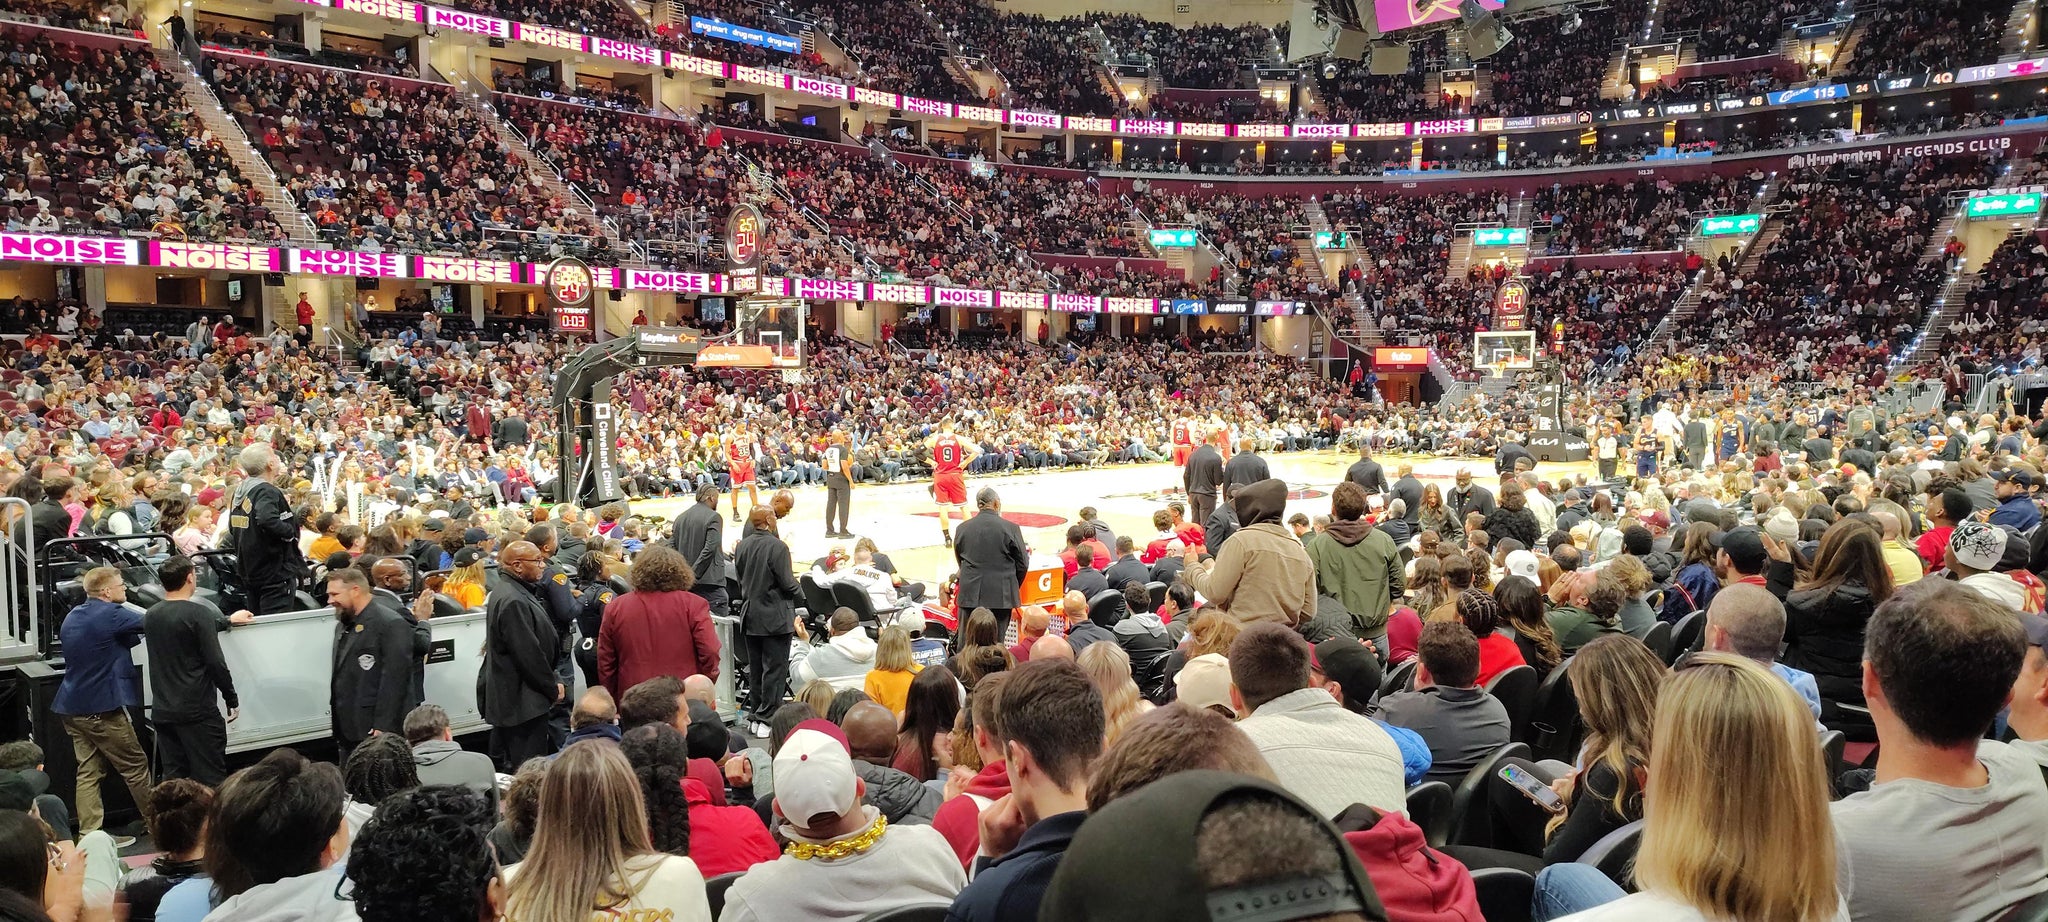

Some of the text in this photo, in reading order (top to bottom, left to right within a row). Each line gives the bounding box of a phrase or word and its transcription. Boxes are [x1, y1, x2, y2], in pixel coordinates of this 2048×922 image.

[343, 0, 416, 21] NOISE
[436, 10, 502, 33] NOISE
[695, 20, 728, 34] drug mart
[520, 28, 583, 51] NOISE
[732, 28, 763, 42] drug mart
[767, 36, 797, 49] drug mart
[670, 57, 724, 77] NOISE
[1970, 67, 1996, 80] 116
[737, 70, 786, 88] NOISE
[1932, 73, 1953, 85] 4Q
[798, 79, 843, 96] NOISE
[1813, 87, 1836, 99] 115
[1855, 83, 1869, 93] 24
[854, 93, 897, 108] NOISE
[1623, 108, 1655, 118] TOL 2
[1667, 102, 1711, 114] FOULS 5
[958, 110, 1003, 123] NOISE
[1014, 113, 1057, 125] NOISE
[1507, 117, 1532, 126] oswald
[1068, 119, 1113, 131] NOISE
[1181, 126, 1226, 136] NOISE
[1297, 126, 1344, 135] NOISE
[1356, 127, 1407, 136] NOISE
[1237, 127, 1285, 137] NOISE
[2, 236, 126, 259] NOISE
[736, 232, 756, 257] 24
[160, 249, 270, 271] NOISE
[423, 264, 511, 283] NOISE
[634, 271, 703, 288] NOISE
[559, 283, 580, 299] 24
[873, 289, 926, 302] NOISE
[940, 291, 987, 303] NOISE
[1000, 296, 1045, 309] NOISE
[1108, 301, 1154, 313] NOISE
[1192, 302, 1204, 313] 31
[1214, 303, 1247, 313] ASSISTS
[1503, 295, 1521, 310] 24
[562, 315, 585, 327] 0:03
[641, 332, 678, 344] KeyBank
[709, 353, 740, 361] State Farm
[1391, 351, 1412, 362] fubo
[1176, 429, 1184, 441] 3
[738, 446, 749, 457] 35
[942, 446, 953, 462] 9
[599, 421, 614, 497] Cleveland Clinic
[854, 568, 880, 581] CAVALIERS
[1038, 572, 1052, 592] G
